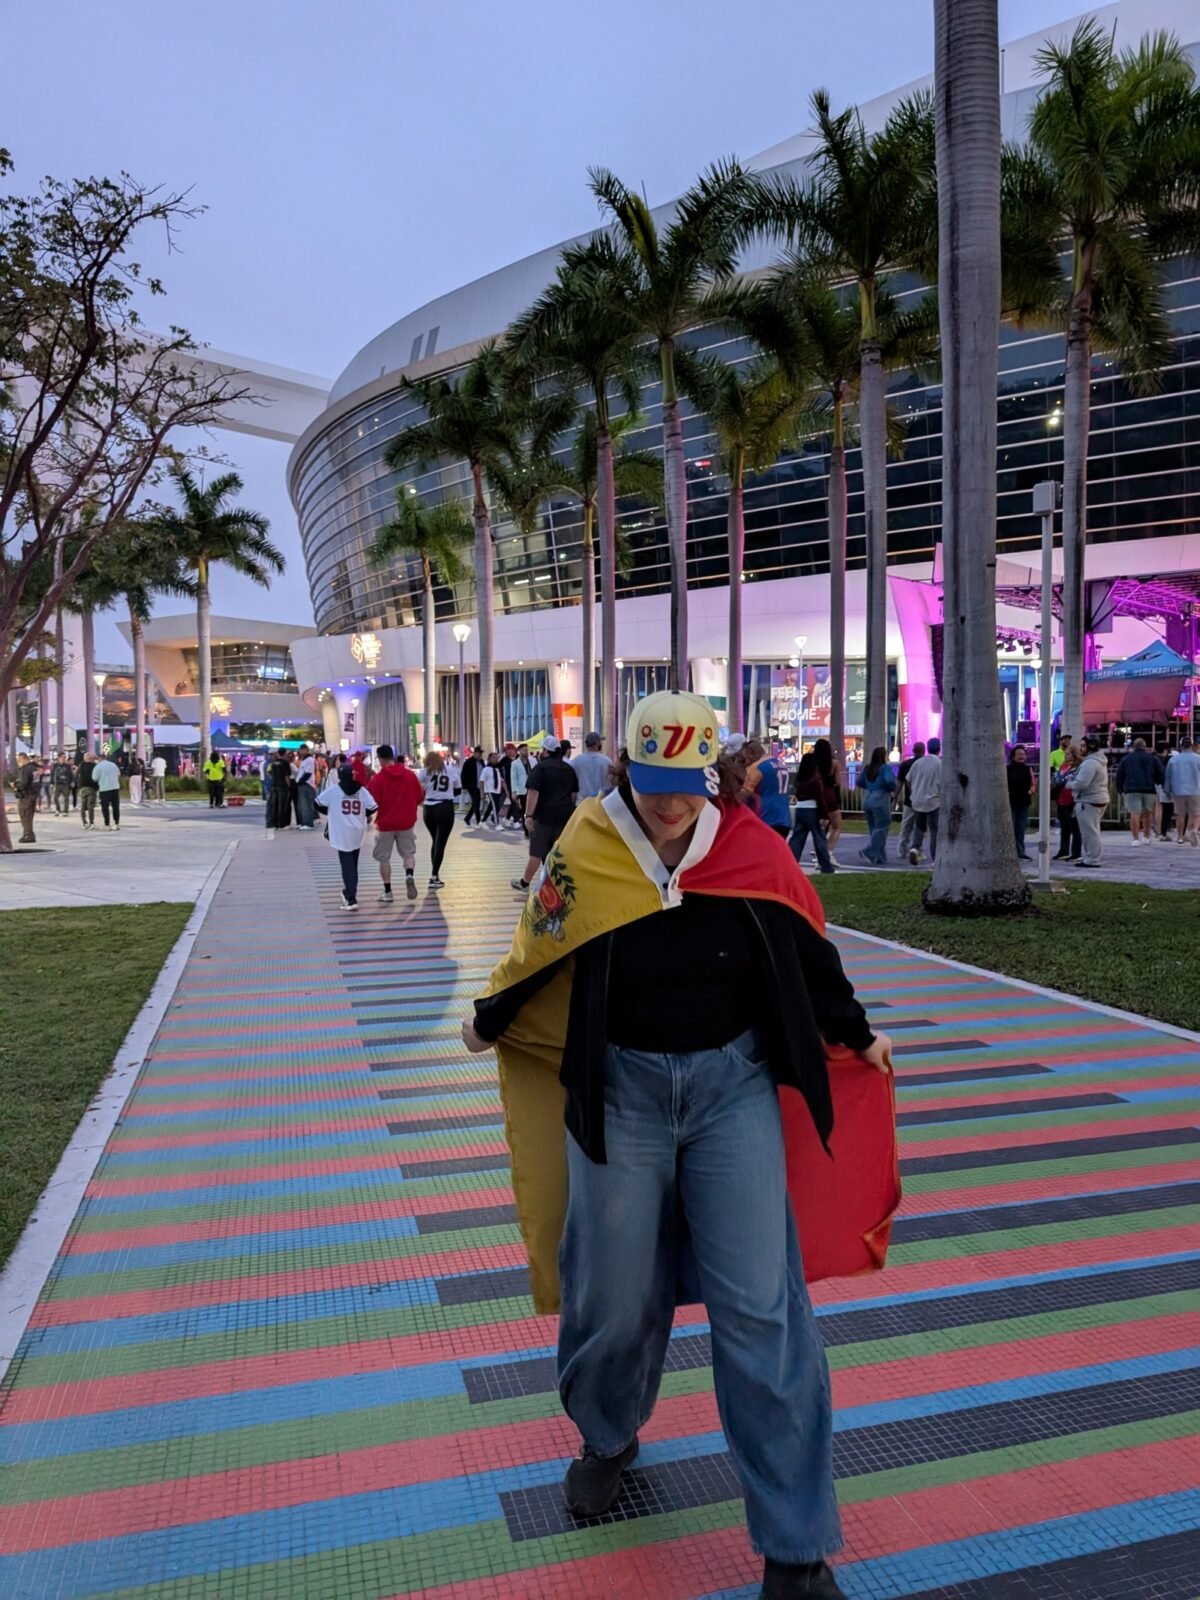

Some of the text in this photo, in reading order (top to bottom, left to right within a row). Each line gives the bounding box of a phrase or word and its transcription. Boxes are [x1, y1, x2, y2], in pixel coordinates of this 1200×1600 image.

[771, 686, 808, 700] FEELS
[811, 696, 831, 708] LIK
[778, 709, 820, 721] HOME.
[430, 774, 449, 793] 19
[777, 770, 789, 794] 17
[341, 799, 361, 816] 99
